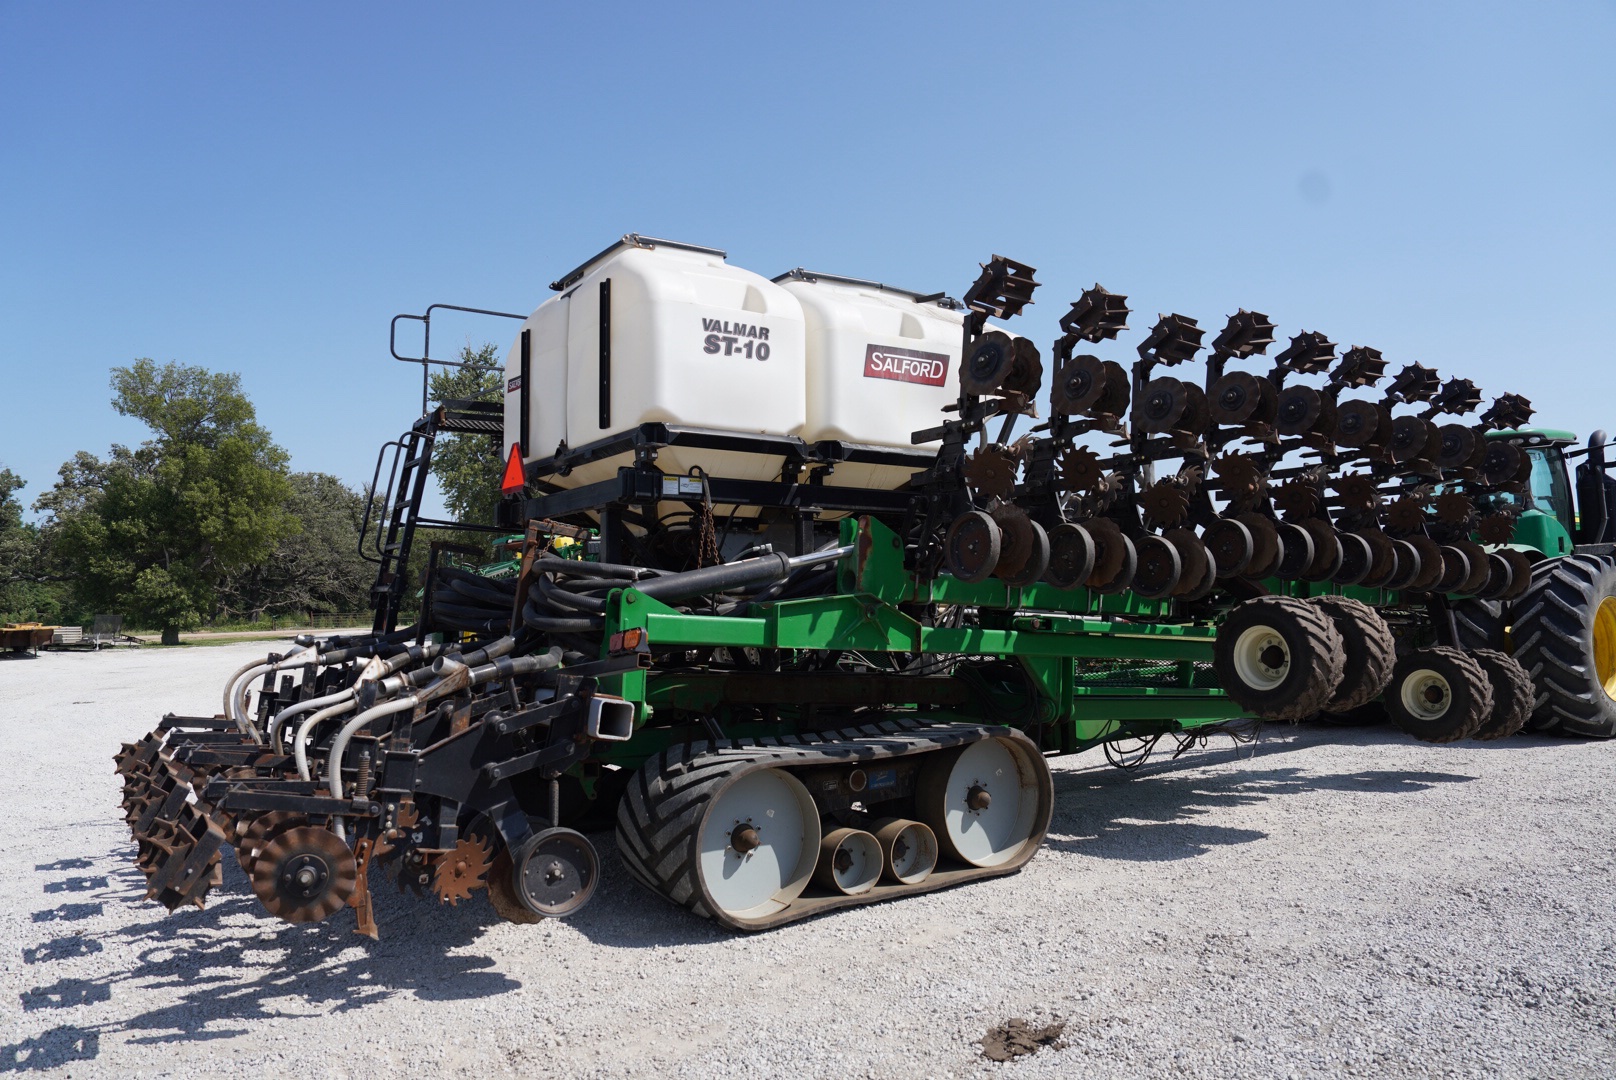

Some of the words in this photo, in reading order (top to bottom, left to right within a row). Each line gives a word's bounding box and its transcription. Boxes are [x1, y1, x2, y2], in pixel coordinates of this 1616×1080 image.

[702, 317, 770, 341] VALMAR
[703, 333, 771, 361] ST-10
[870, 351, 944, 379] SALFORD
